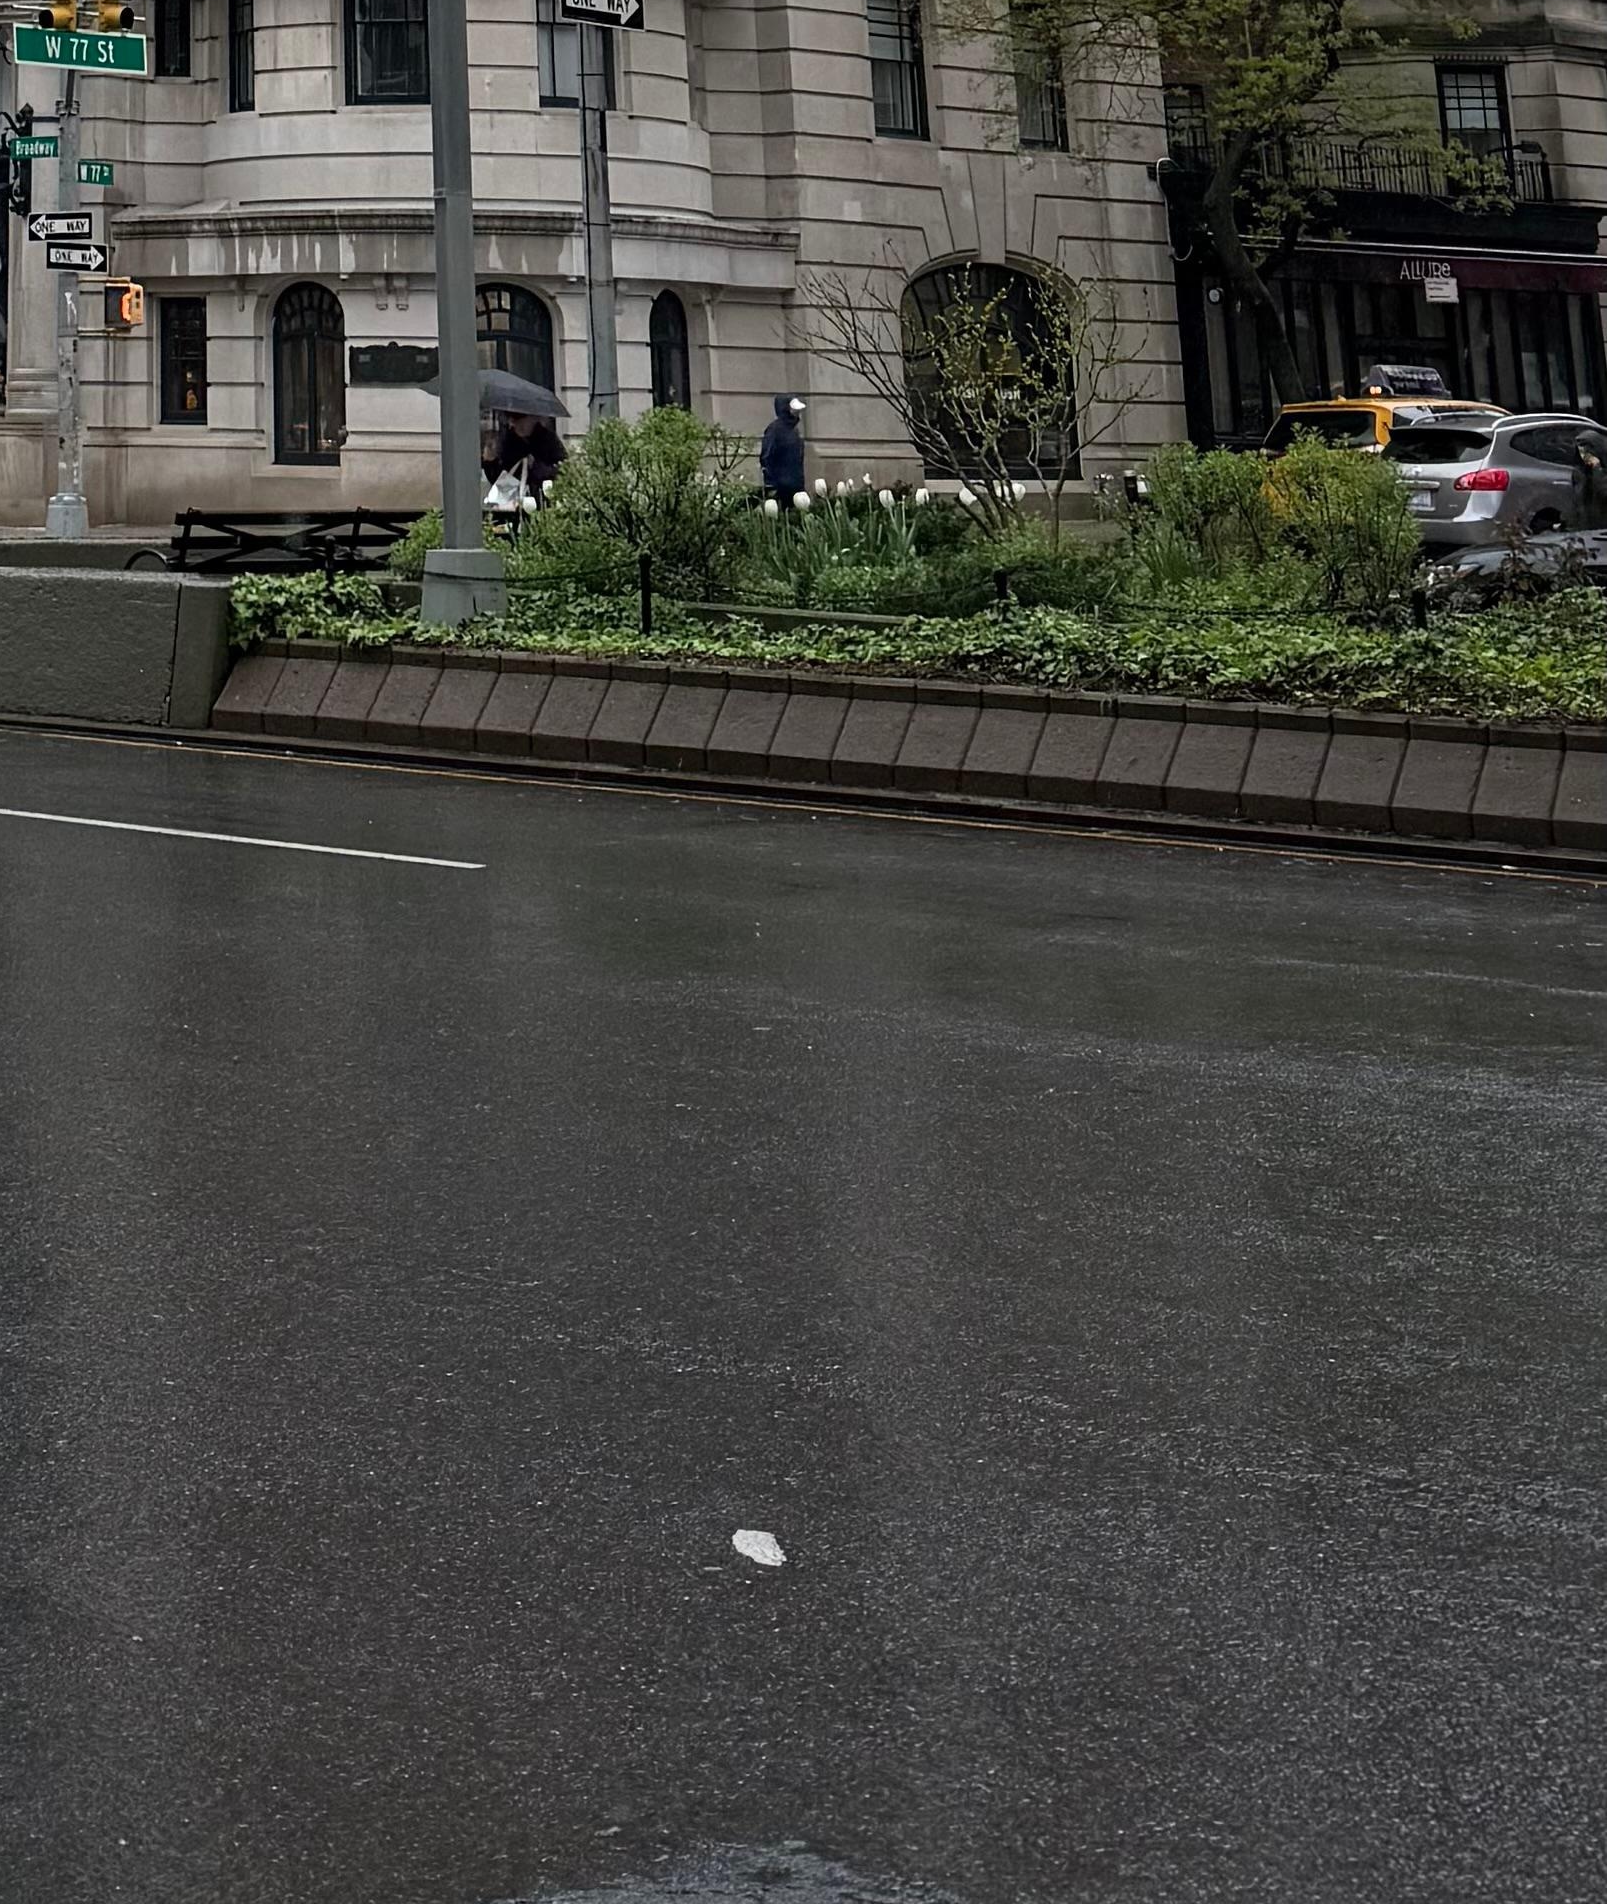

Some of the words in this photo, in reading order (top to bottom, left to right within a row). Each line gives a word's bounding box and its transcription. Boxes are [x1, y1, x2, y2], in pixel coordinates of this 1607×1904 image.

[46, 35, 61, 59] W
[69, 38, 89, 62] 77
[97, 40, 115, 64] St
[15, 140, 55, 159] Broadway
[80, 164, 88, 181] W
[90, 165, 101, 182] 77
[35, 221, 55, 233] ONE
[66, 220, 86, 231] WAY
[55, 251, 73, 262] ONE
[81, 252, 98, 264] WAY
